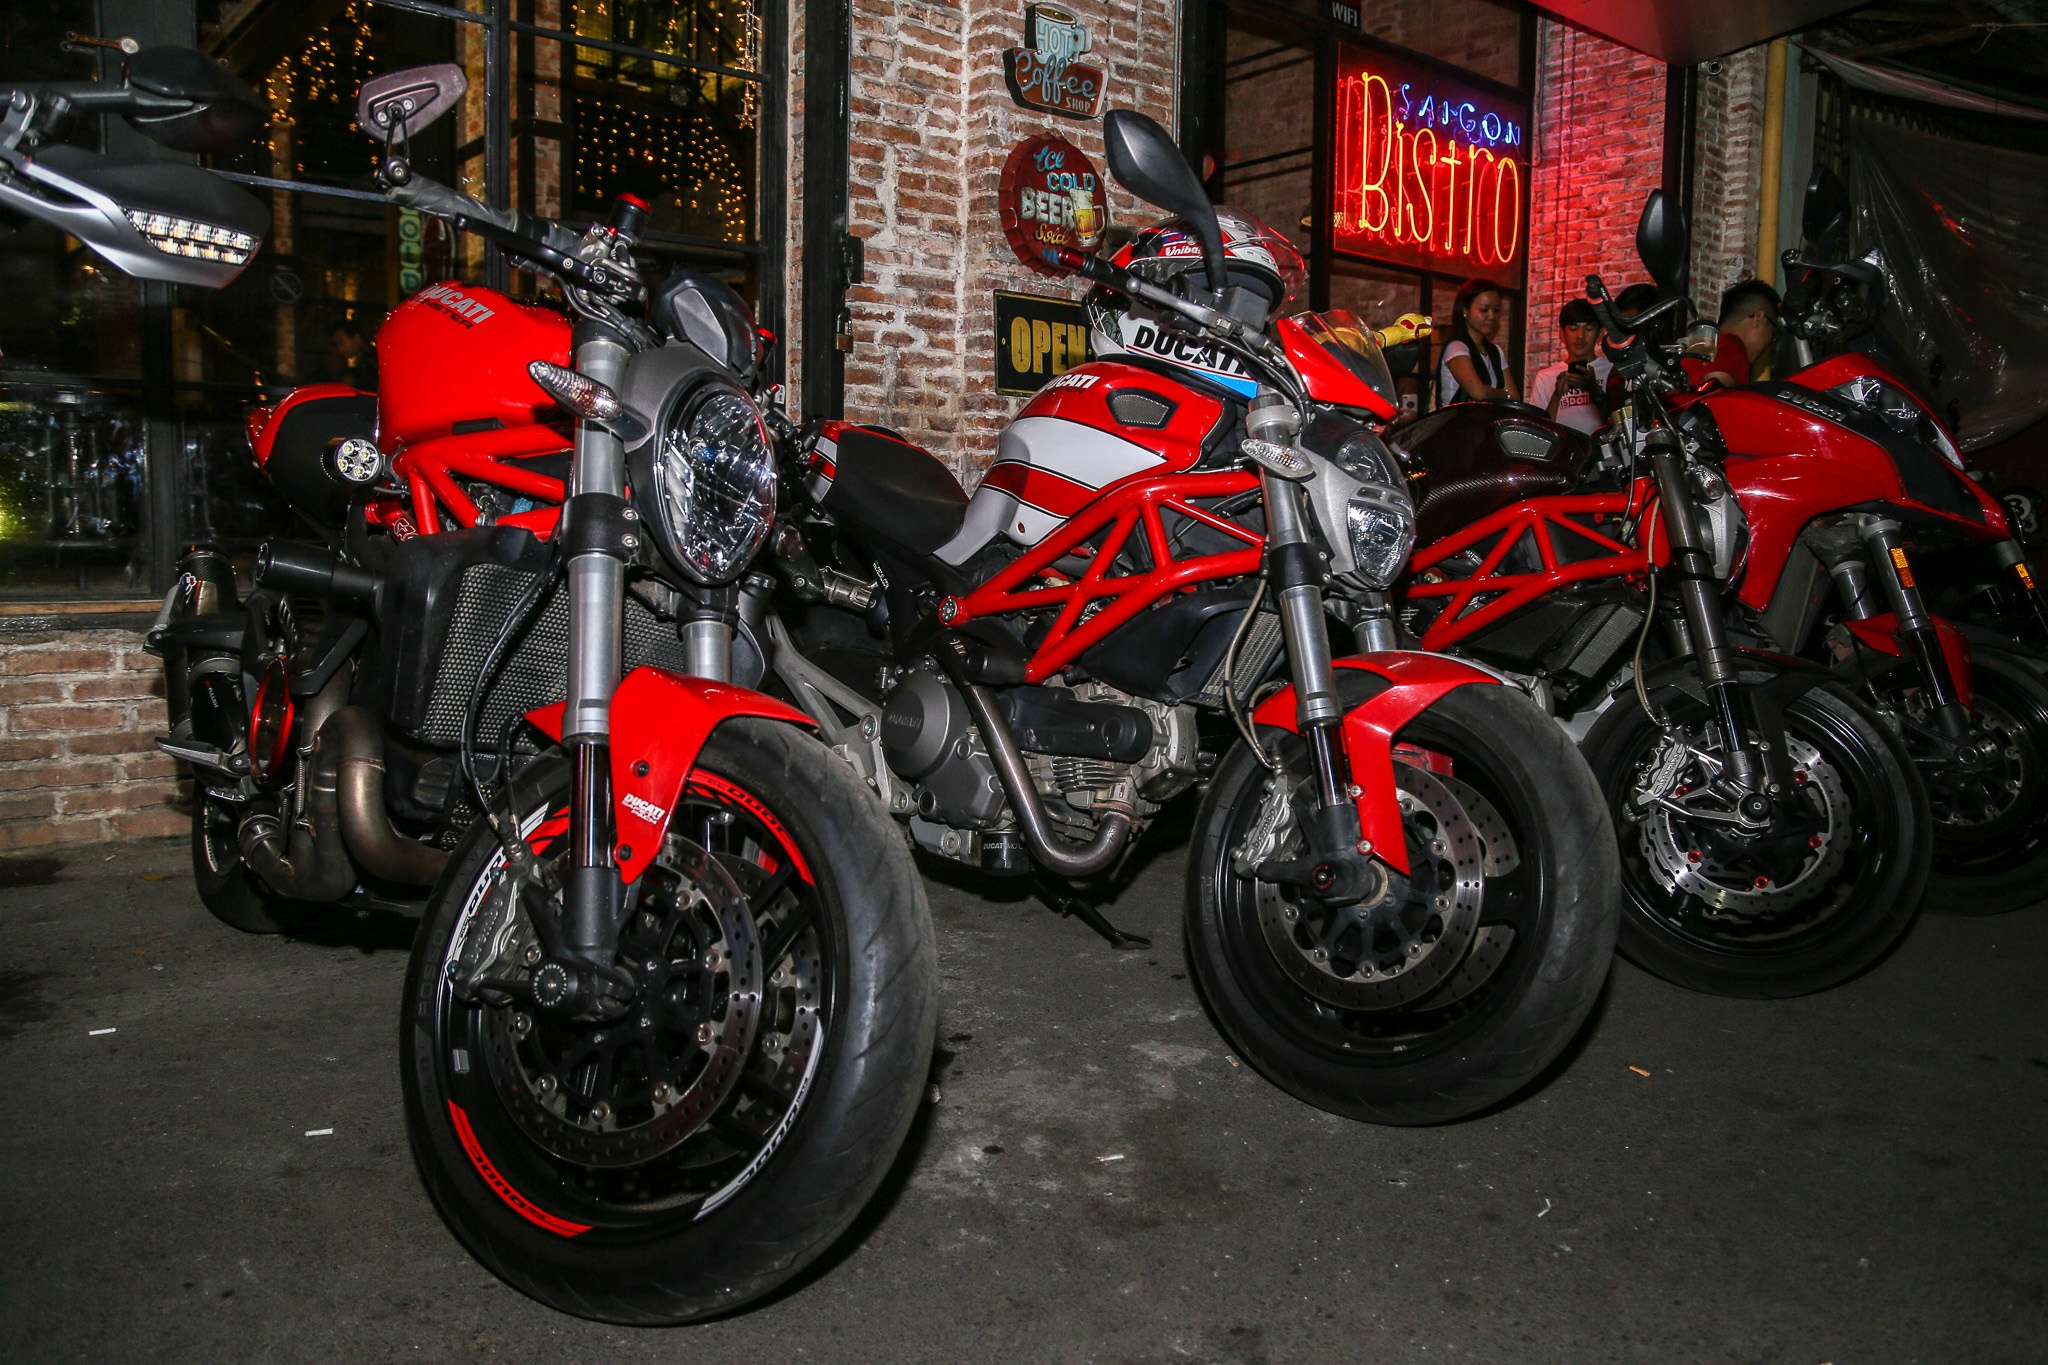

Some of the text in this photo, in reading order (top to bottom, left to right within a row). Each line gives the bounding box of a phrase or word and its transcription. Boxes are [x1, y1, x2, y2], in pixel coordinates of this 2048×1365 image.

[1332, 2, 1358, 27] WIFI
[1035, 20, 1073, 57] HOT
[1015, 51, 1098, 104] Coffee
[1065, 97, 1091, 112] SHOP
[1402, 84, 1520, 146] SAIGON
[1033, 146, 1065, 172] Ice
[1047, 172, 1096, 192] COLD
[1021, 187, 1076, 230] BEER
[1034, 223, 1071, 246] Sold
[1165, 244, 1201, 257] Uniba
[1011, 316, 1086, 375] OPEN
[1777, 389, 1847, 422] DUCATI
[624, 793, 666, 818] DUCATI
[1251, 808, 1278, 851] brembo
[418, 929, 446, 1017] ROSSO
